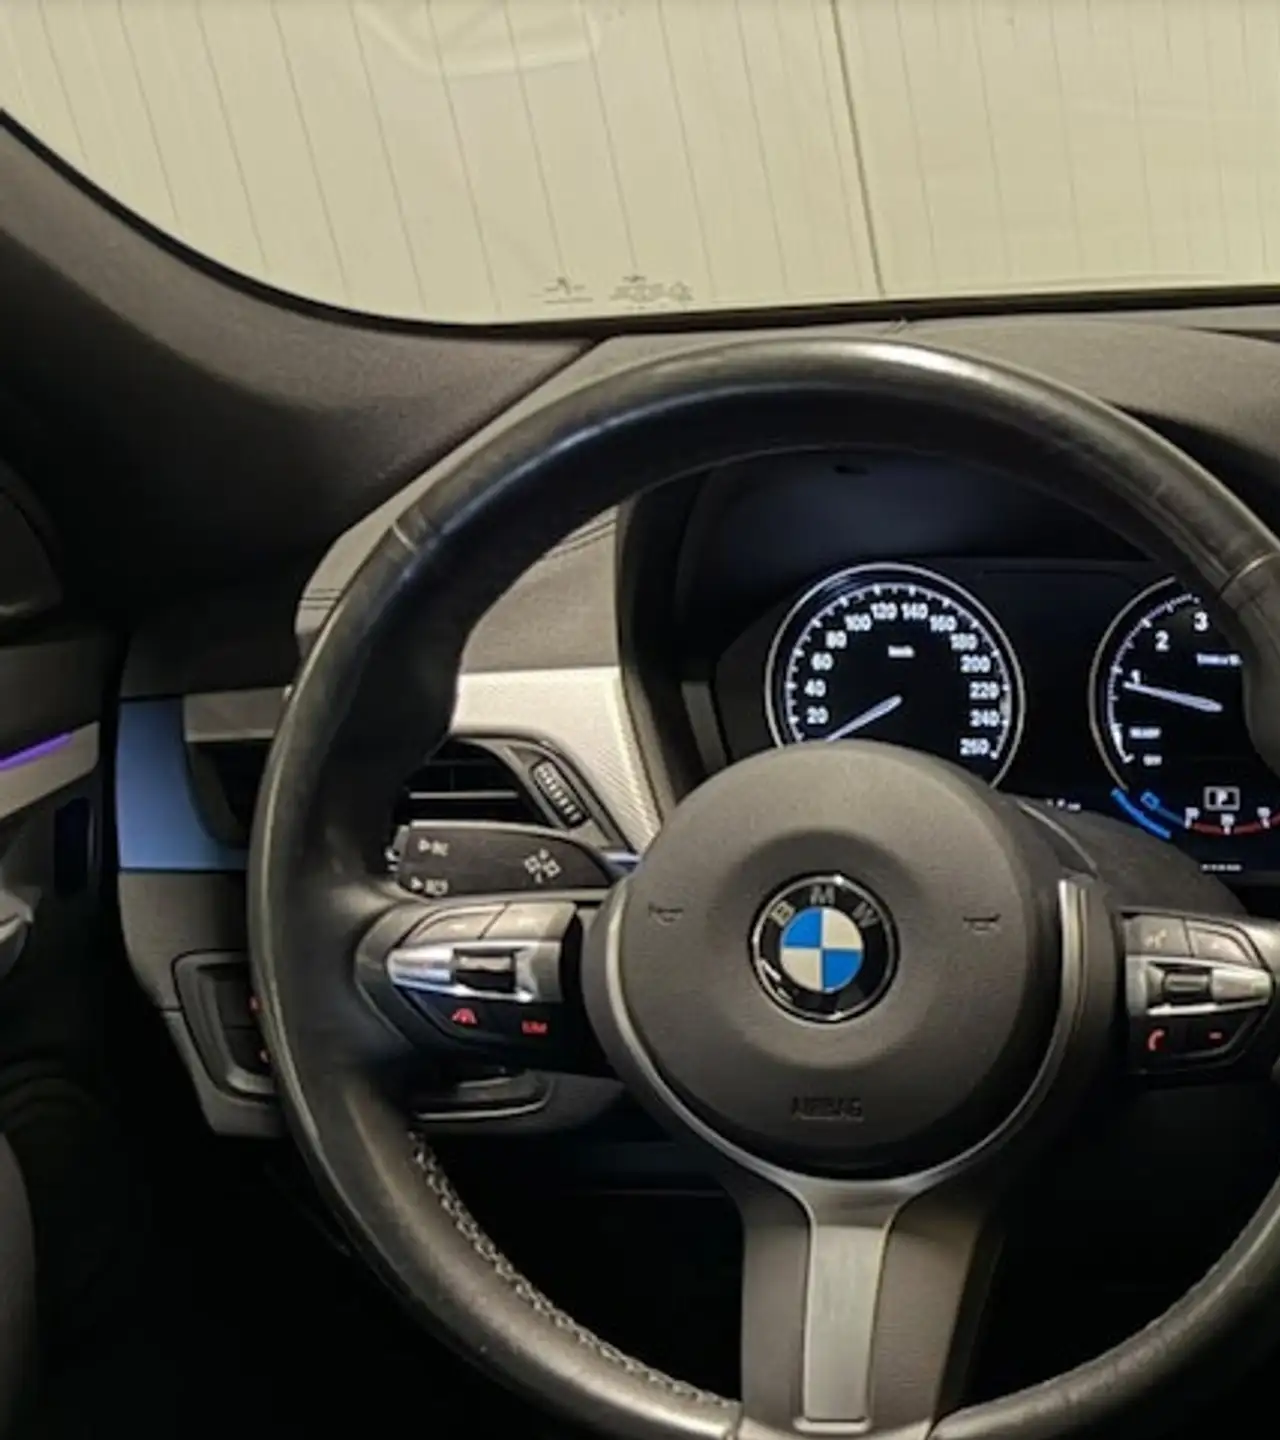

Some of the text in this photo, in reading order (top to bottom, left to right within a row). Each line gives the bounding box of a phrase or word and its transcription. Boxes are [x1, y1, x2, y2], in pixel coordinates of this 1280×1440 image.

[870, 602, 898, 620] 120
[901, 602, 928, 620] 140
[1194, 611, 1208, 631] 3
[825, 630, 847, 648] 80
[1155, 630, 1169, 650] 2
[811, 652, 833, 670] 60
[960, 654, 991, 673] 200
[804, 678, 826, 697] 40
[969, 681, 1000, 699] 220
[806, 706, 828, 724] 20
[969, 708, 1000, 727] 240
[770, 884, 880, 929] BMW
